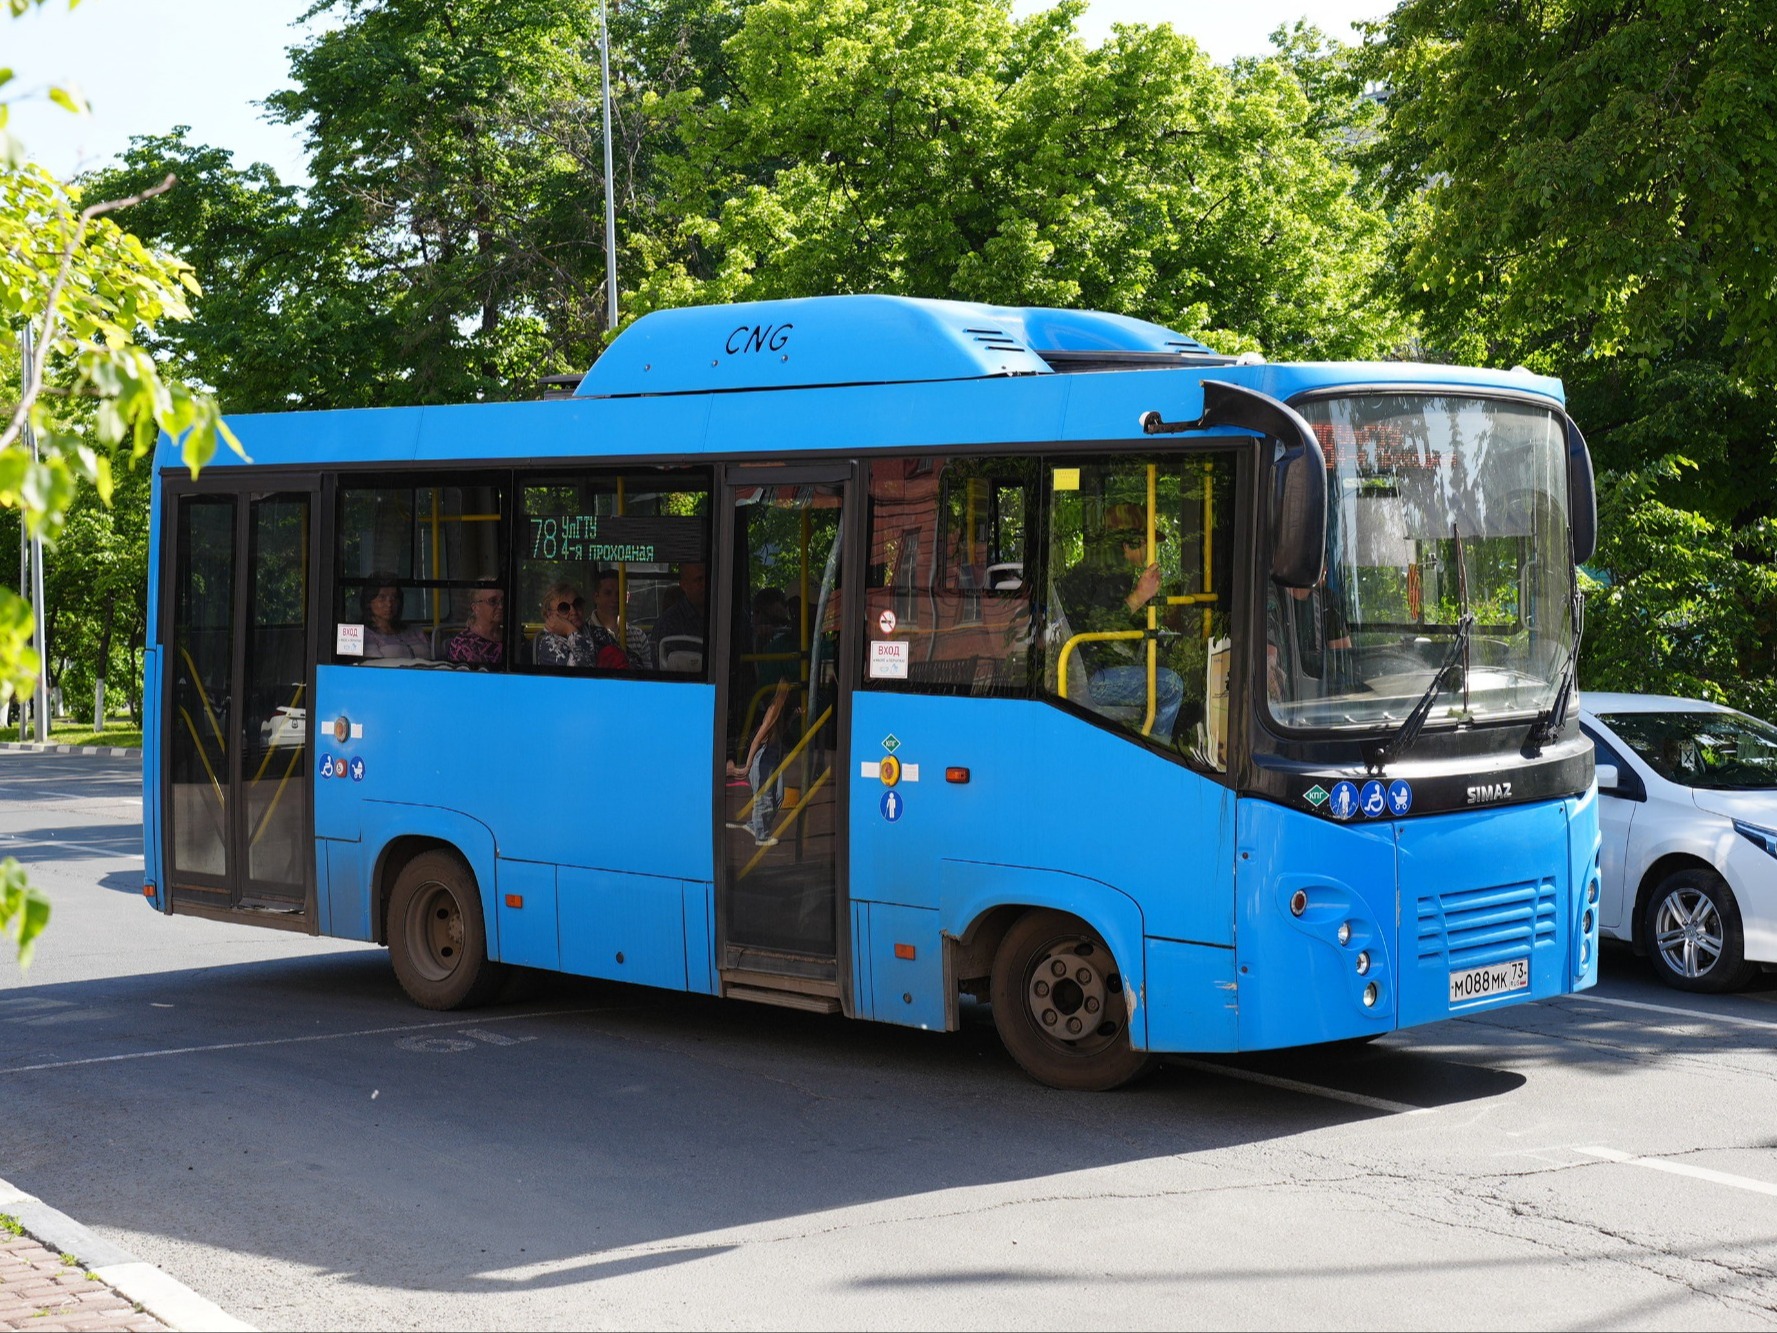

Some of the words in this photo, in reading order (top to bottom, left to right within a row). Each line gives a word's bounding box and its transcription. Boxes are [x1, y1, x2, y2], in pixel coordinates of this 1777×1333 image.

[725, 323, 794, 355] CNG
[530, 518, 557, 559] 78
[342, 627, 358, 637] ВХОД
[878, 645, 900, 657] ВХОД
[1309, 791, 1324, 800] КПГ
[1466, 782, 1513, 804] SIMAZ
[1511, 962, 1525, 980] 73
